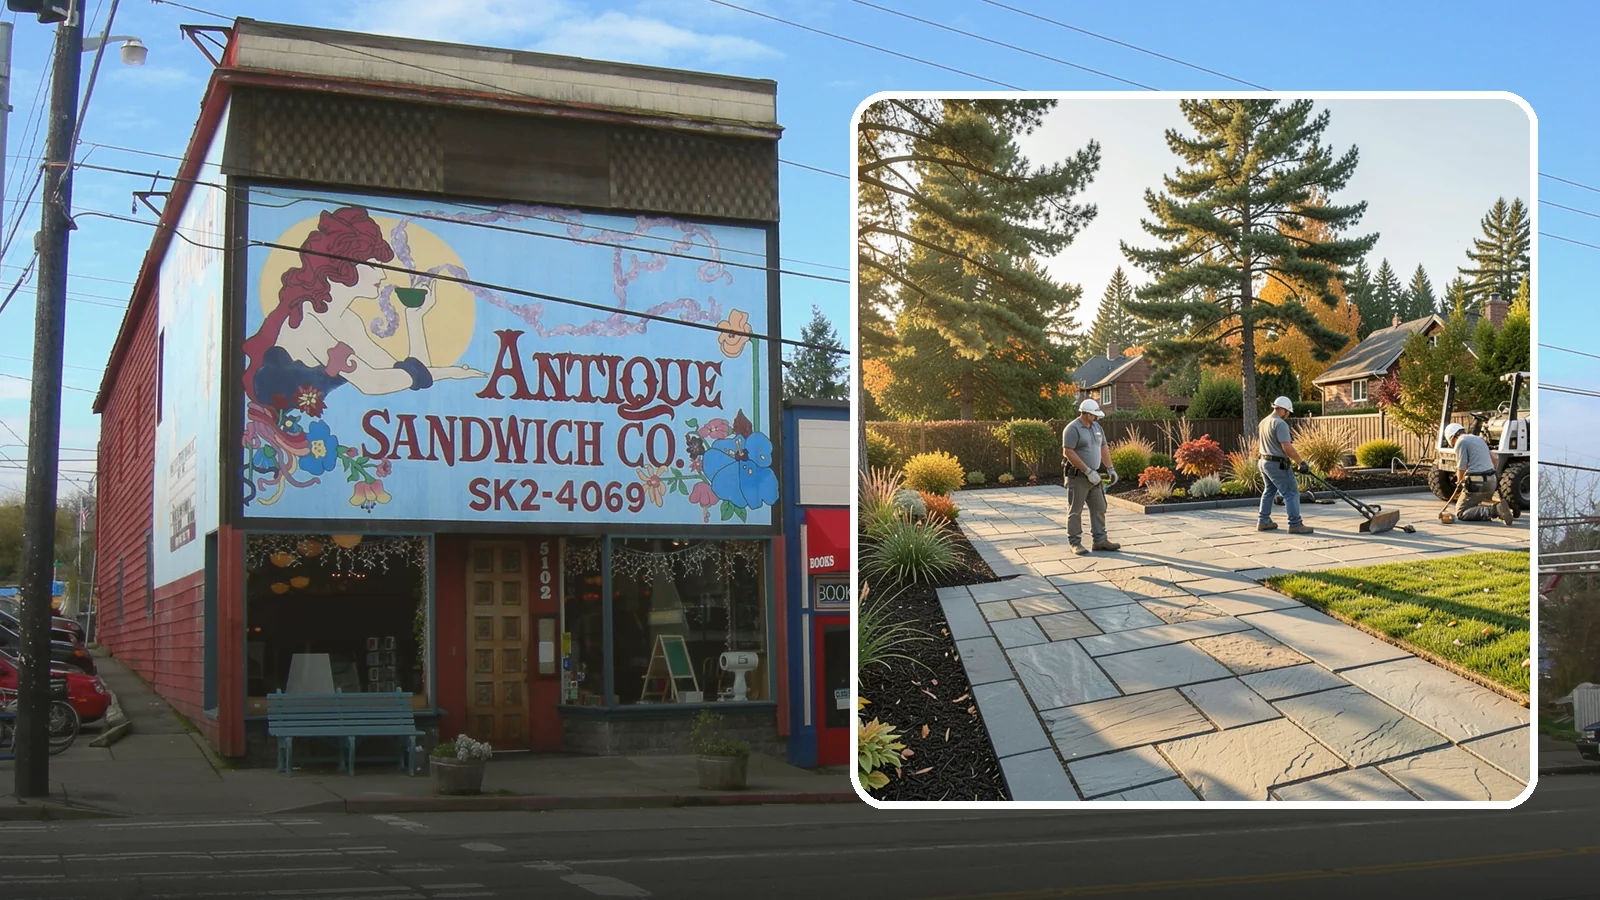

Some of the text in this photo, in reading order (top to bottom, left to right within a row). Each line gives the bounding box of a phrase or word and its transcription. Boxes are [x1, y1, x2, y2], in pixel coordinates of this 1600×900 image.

[475, 328, 724, 421] ANTIQUE
[361, 408, 685, 469] SANDWICH CO.
[468, 476, 646, 513] SK2-4069
[539, 541, 551, 600] 5102
[809, 555, 835, 569] BOOKS
